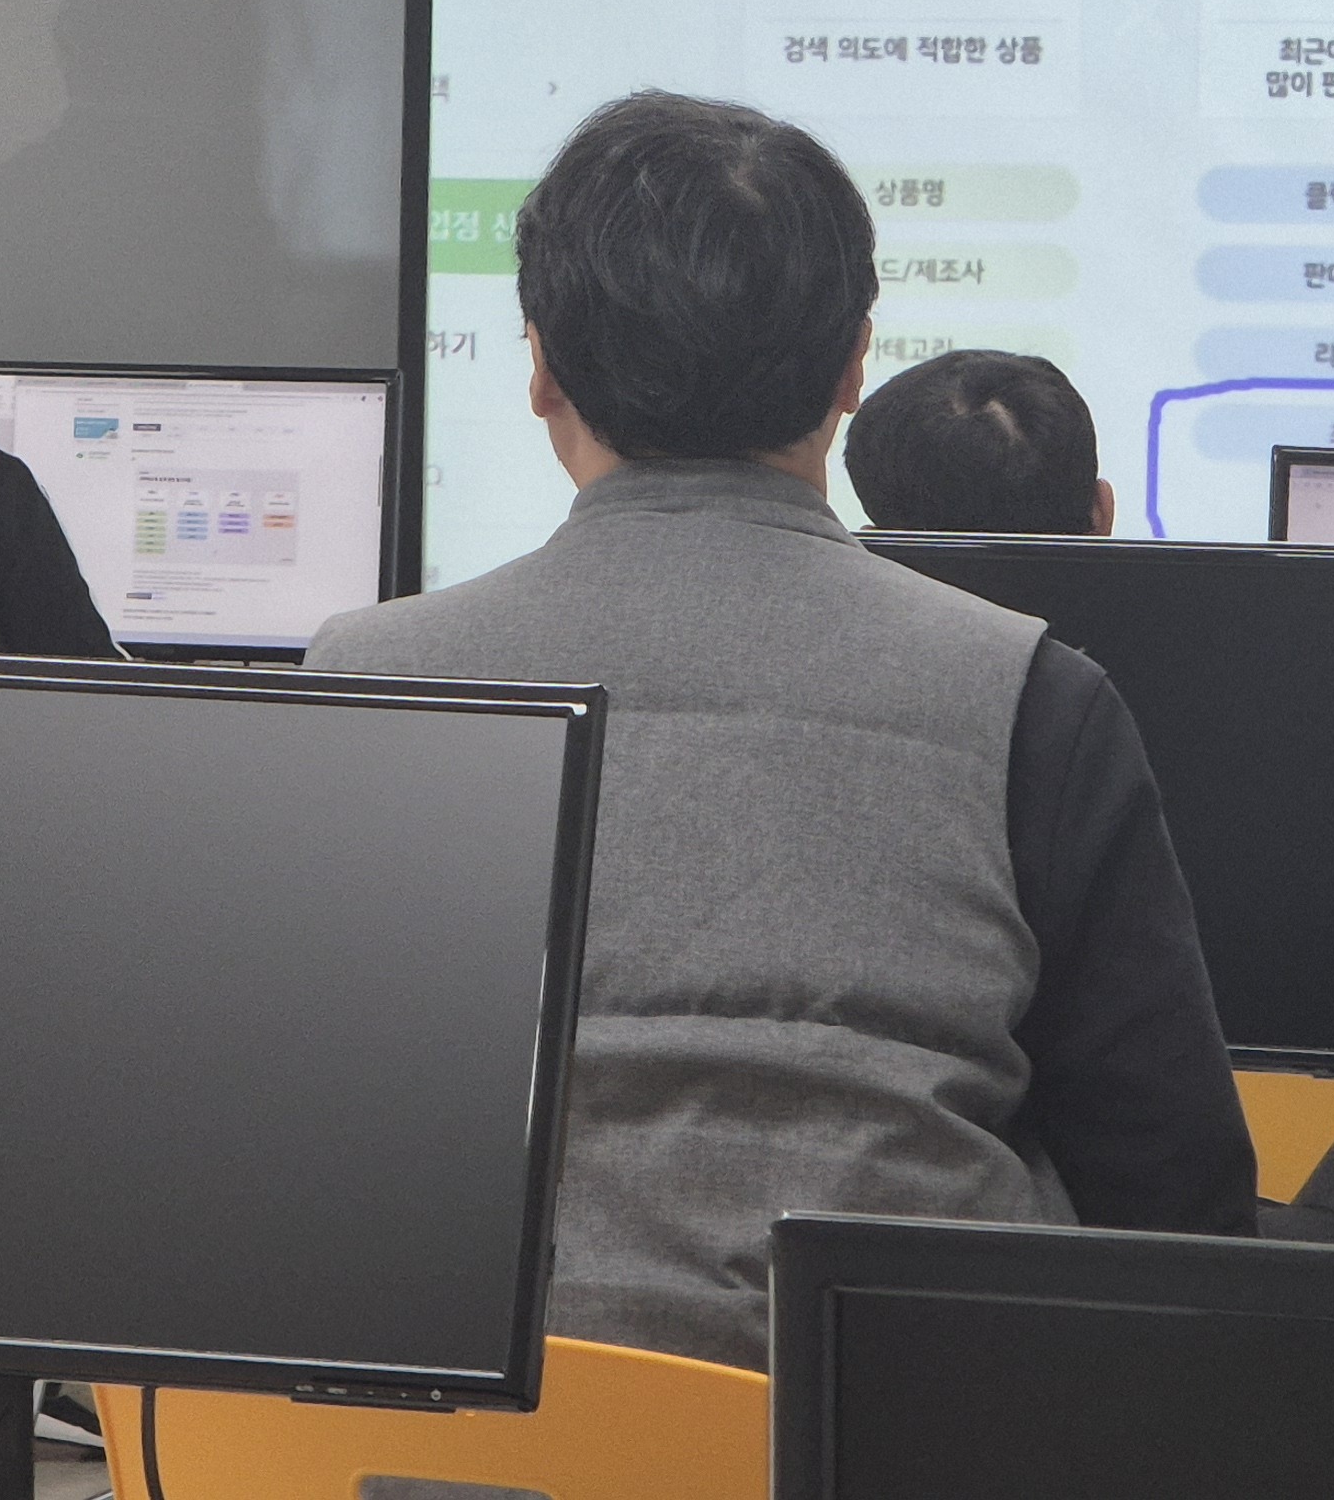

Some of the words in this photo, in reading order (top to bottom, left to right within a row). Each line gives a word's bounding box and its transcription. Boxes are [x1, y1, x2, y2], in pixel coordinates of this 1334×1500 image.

[784, 36, 828, 63] 검색
[838, 36, 907, 62] 의도에
[917, 37, 987, 63] 적합한
[996, 36, 1042, 63] 상품
[1266, 71, 1313, 98] 많이
[875, 179, 945, 206] 상품명
[876, 258, 985, 285] 드/제조사
